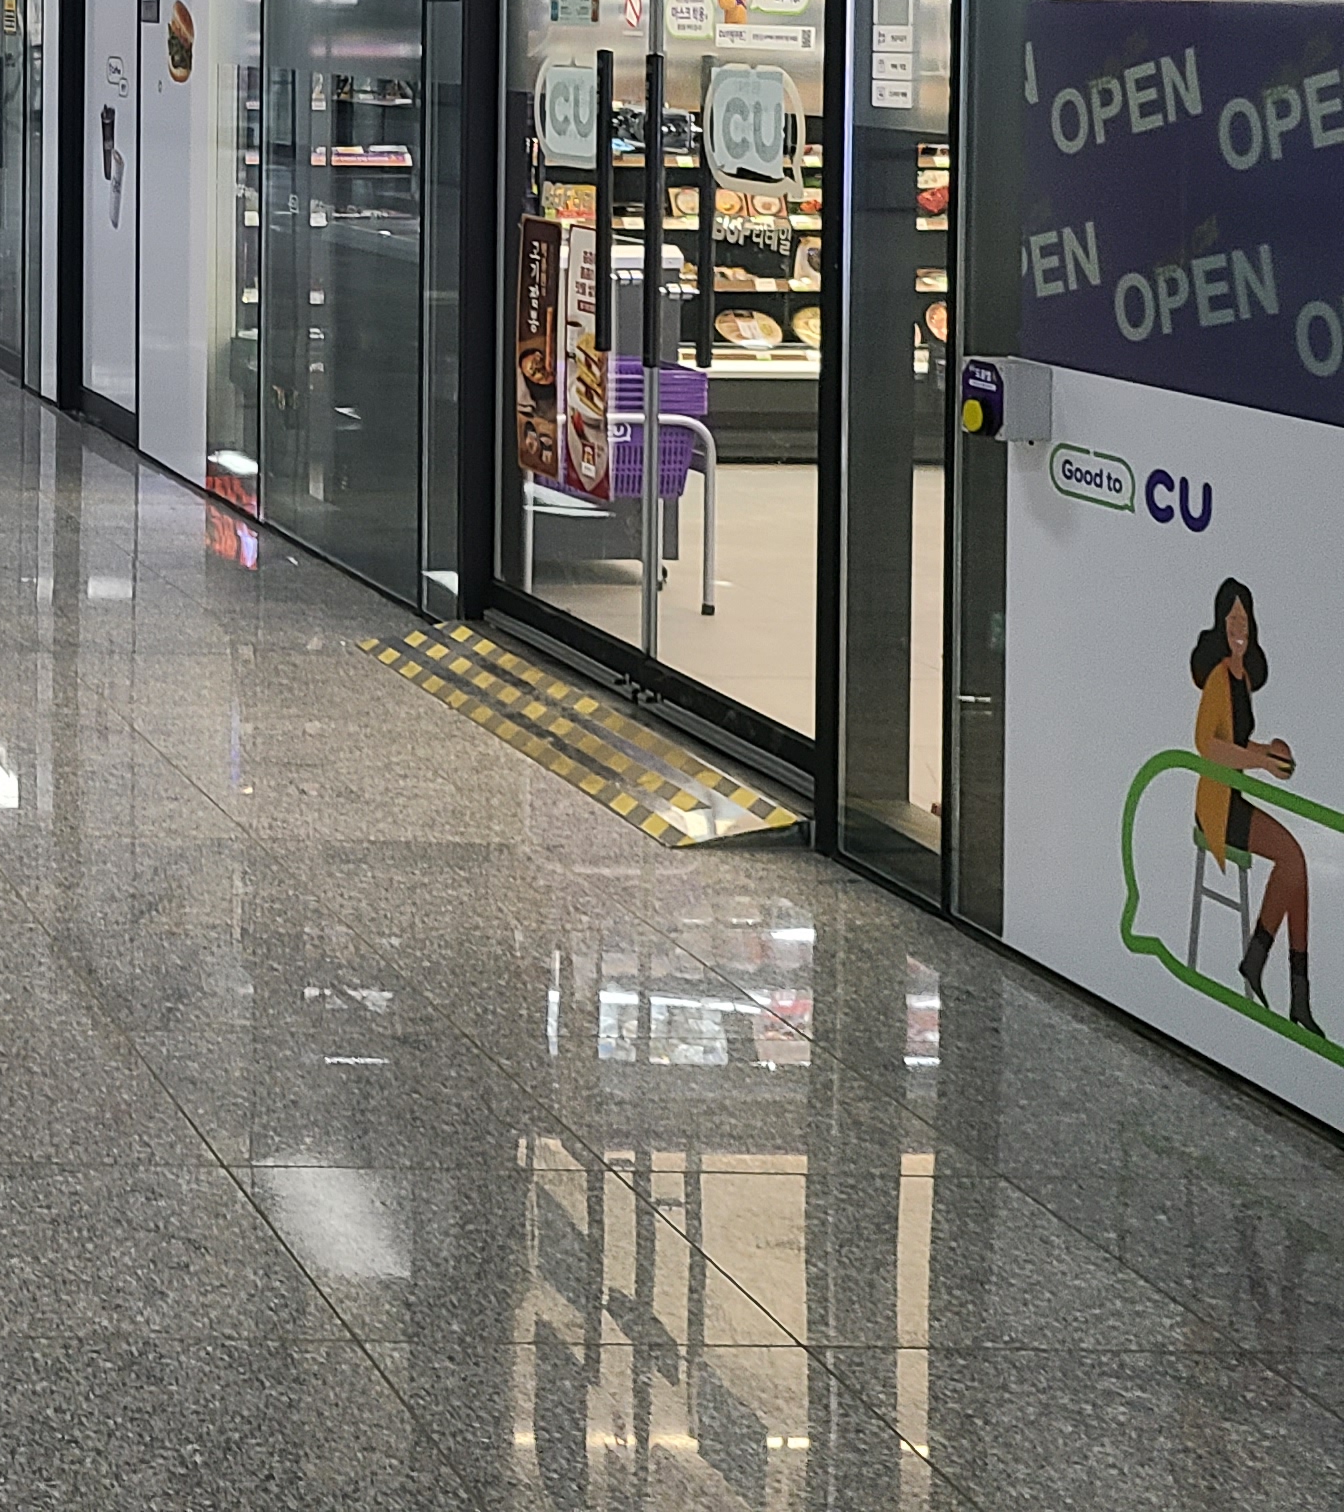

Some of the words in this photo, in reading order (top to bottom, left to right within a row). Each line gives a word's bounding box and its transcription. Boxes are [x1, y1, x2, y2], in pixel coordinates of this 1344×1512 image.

[722, 97, 783, 163] CU
[1051, 46, 1203, 155] OPEN
[1021, 221, 1101, 297] EN
[1113, 243, 1279, 342] OPEN
[1062, 459, 1103, 488] Good
[1106, 471, 1123, 493] to
[1144, 468, 1212, 533] CU
